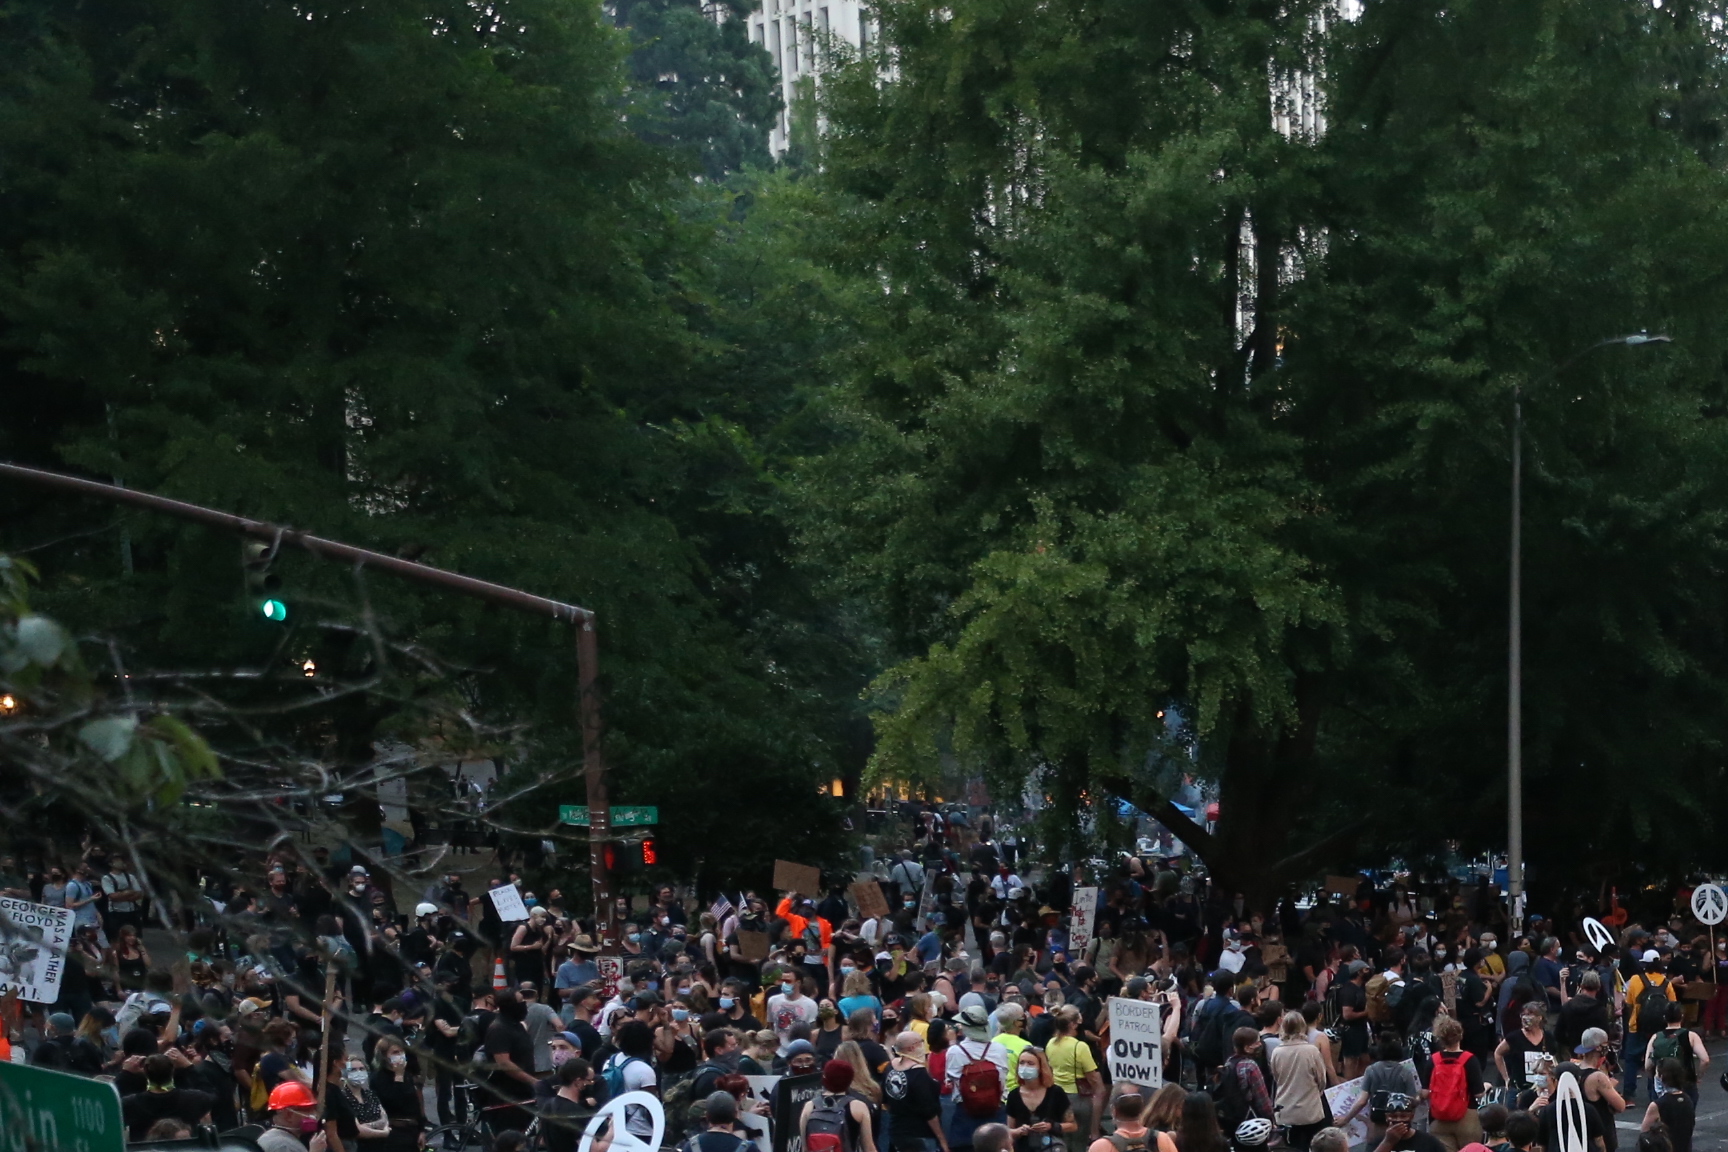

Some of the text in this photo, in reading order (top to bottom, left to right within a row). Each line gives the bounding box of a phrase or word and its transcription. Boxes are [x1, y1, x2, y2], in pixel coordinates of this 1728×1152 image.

[1, 899, 56, 915] GEORGE
[12, 912, 53, 927] FLOYD
[54, 910, 67, 934] WAS
[44, 947, 61, 984] ATHER
[1115, 1002, 1154, 1019] BORDER
[1118, 1019, 1155, 1034] PATROL
[1114, 1038, 1158, 1060] OUT
[1116, 1062, 1157, 1082] NOW!
